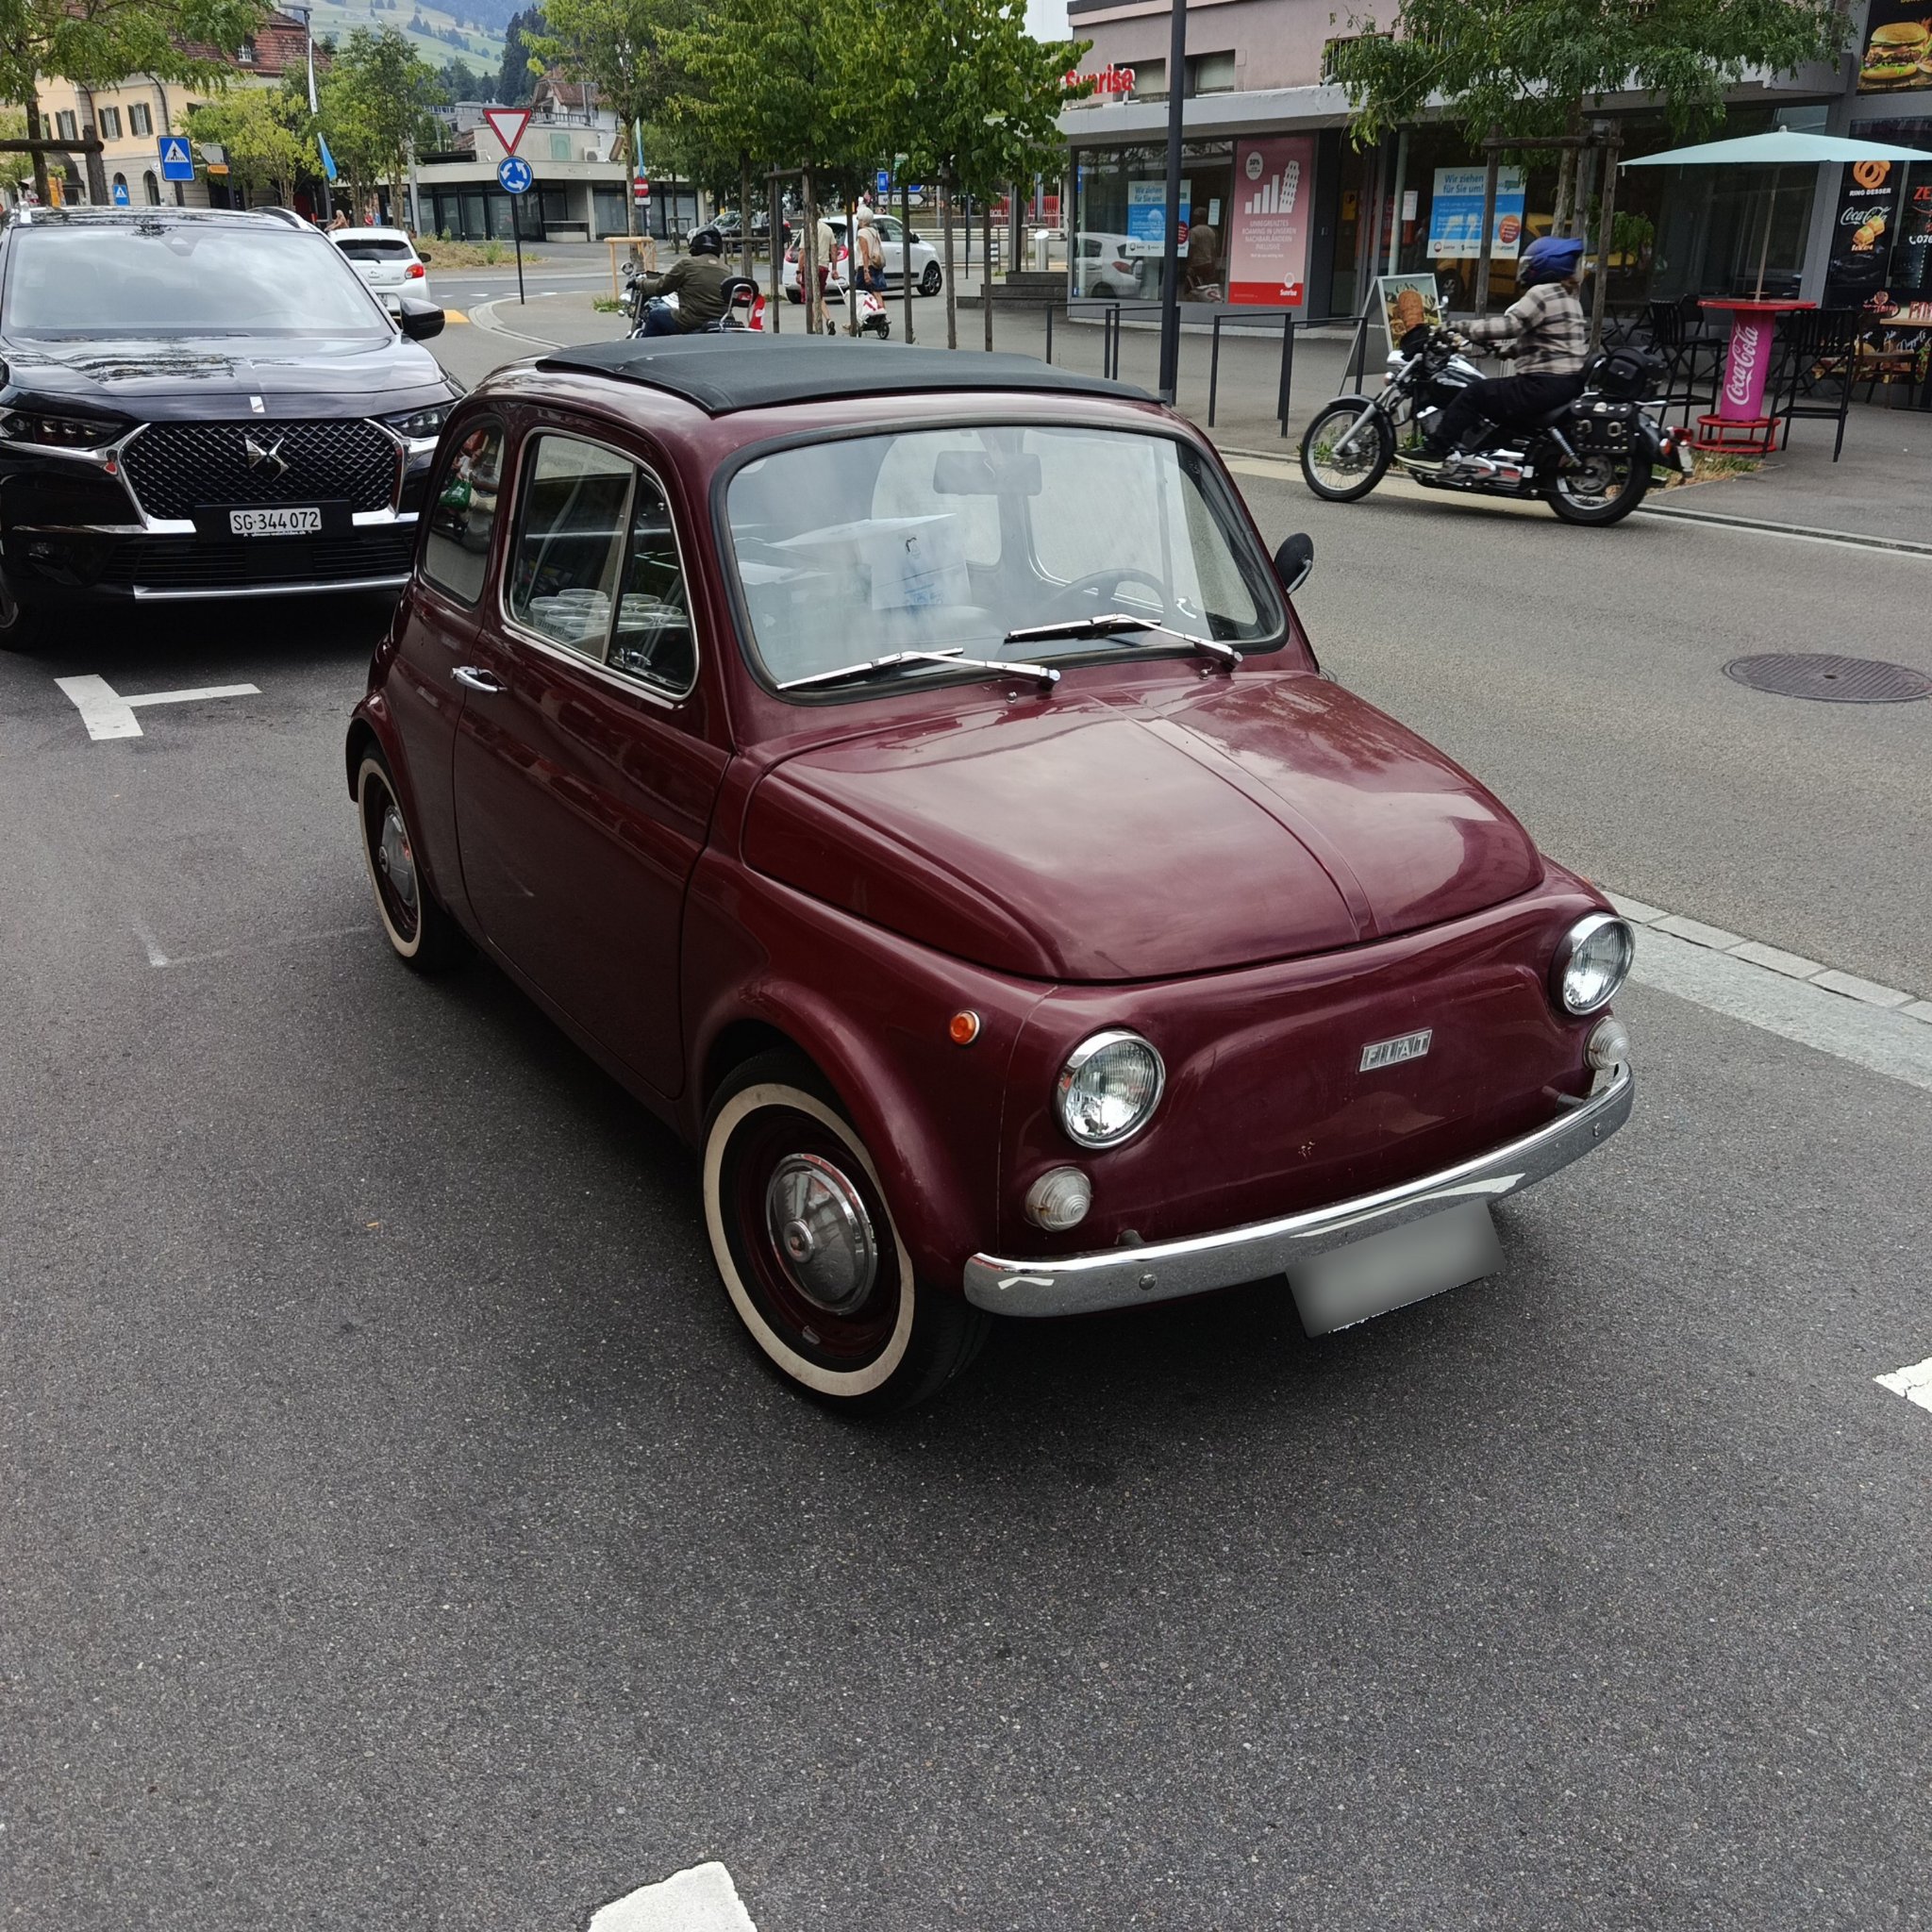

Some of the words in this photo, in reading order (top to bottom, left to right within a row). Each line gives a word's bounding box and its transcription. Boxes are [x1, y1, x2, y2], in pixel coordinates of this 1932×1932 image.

[1444, 174, 1457, 184] Wir
[1458, 174, 1484, 183] ziehen
[1442, 184, 1455, 194] für
[1456, 184, 1467, 193] Sie
[1468, 183, 1484, 192] um!
[1279, 289, 1297, 297] Sunrise
[1365, 1033, 1429, 1067] FIAT
